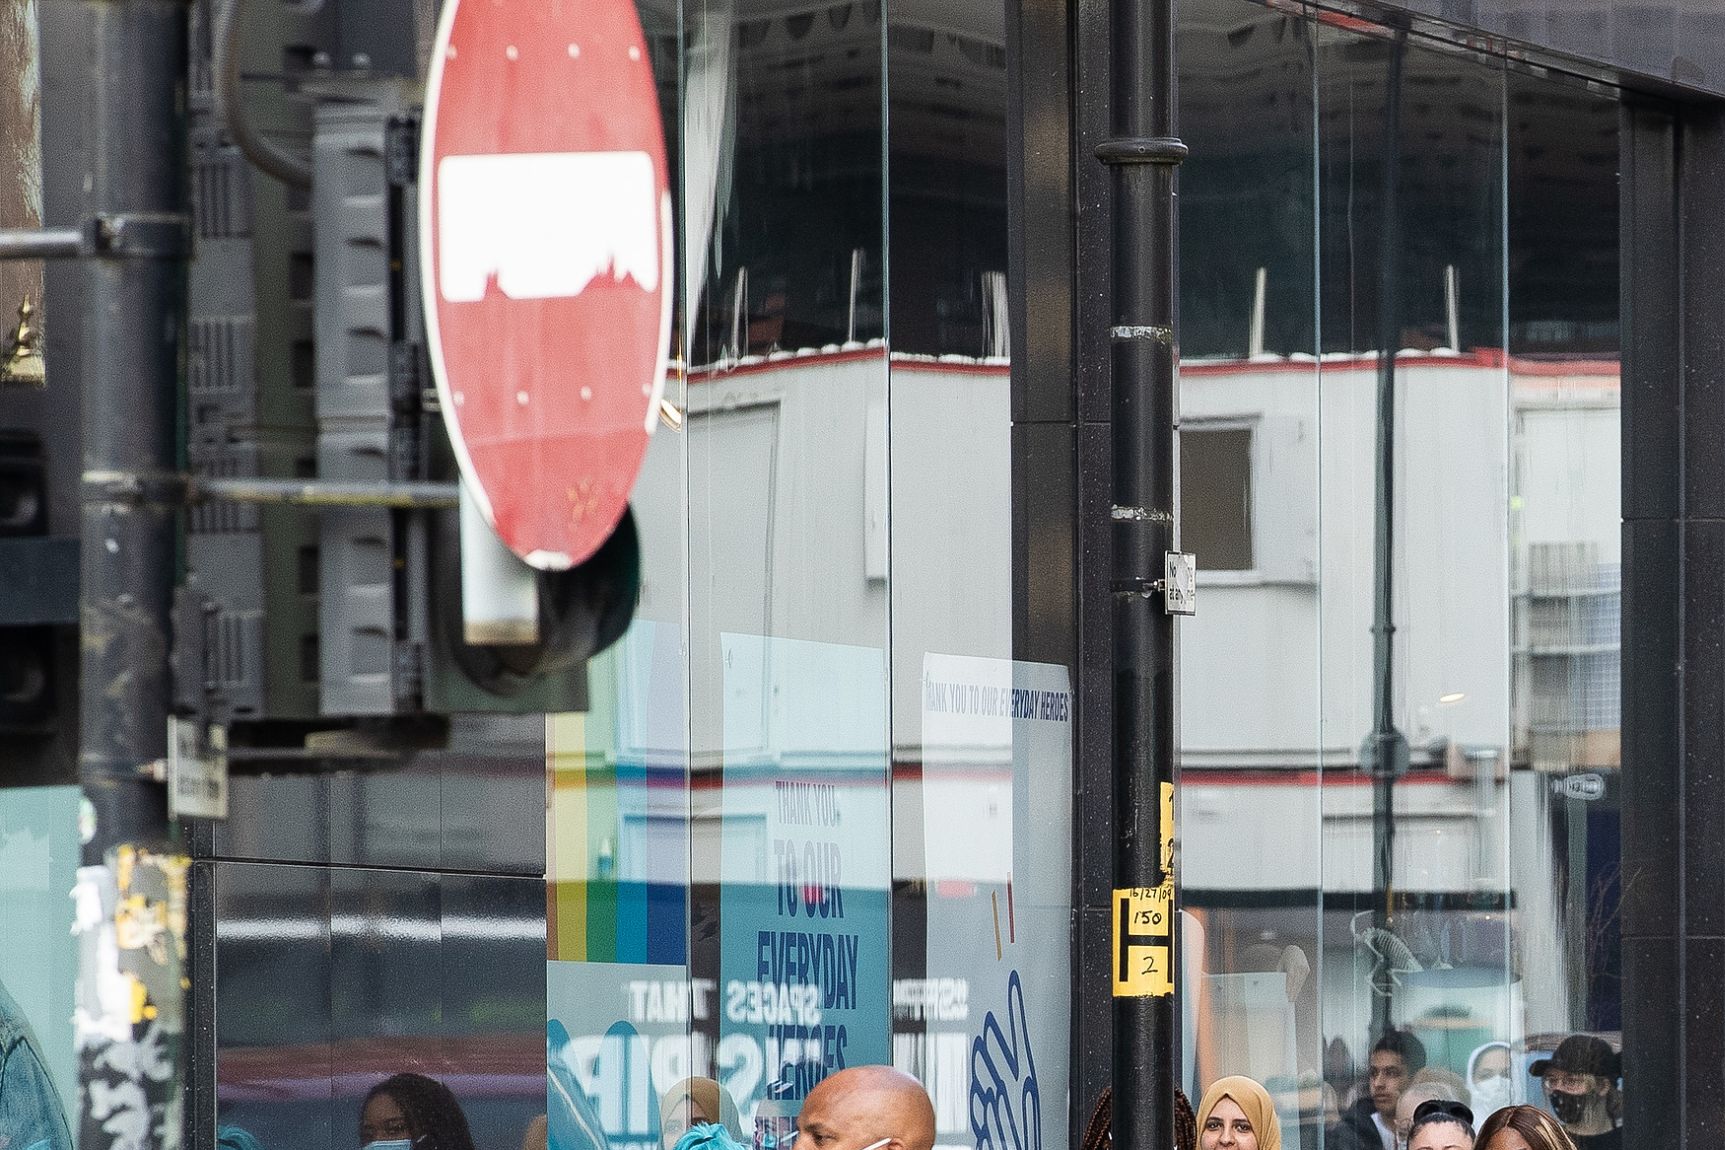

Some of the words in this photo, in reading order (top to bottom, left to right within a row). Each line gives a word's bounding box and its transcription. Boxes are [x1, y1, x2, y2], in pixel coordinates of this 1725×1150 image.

[949, 683, 967, 715] YOU
[969, 684, 980, 716] TO
[981, 685, 998, 717] OUR
[1000, 686, 1040, 720] EVERYDAY
[1040, 690, 1068, 723] HEROES
[775, 780, 812, 826] THANK
[773, 839, 798, 917] TO
[803, 840, 845, 919] OUR
[1133, 910, 1162, 925] 150
[757, 930, 860, 1011] EVERYDAY
[1141, 956, 1158, 975] 2
